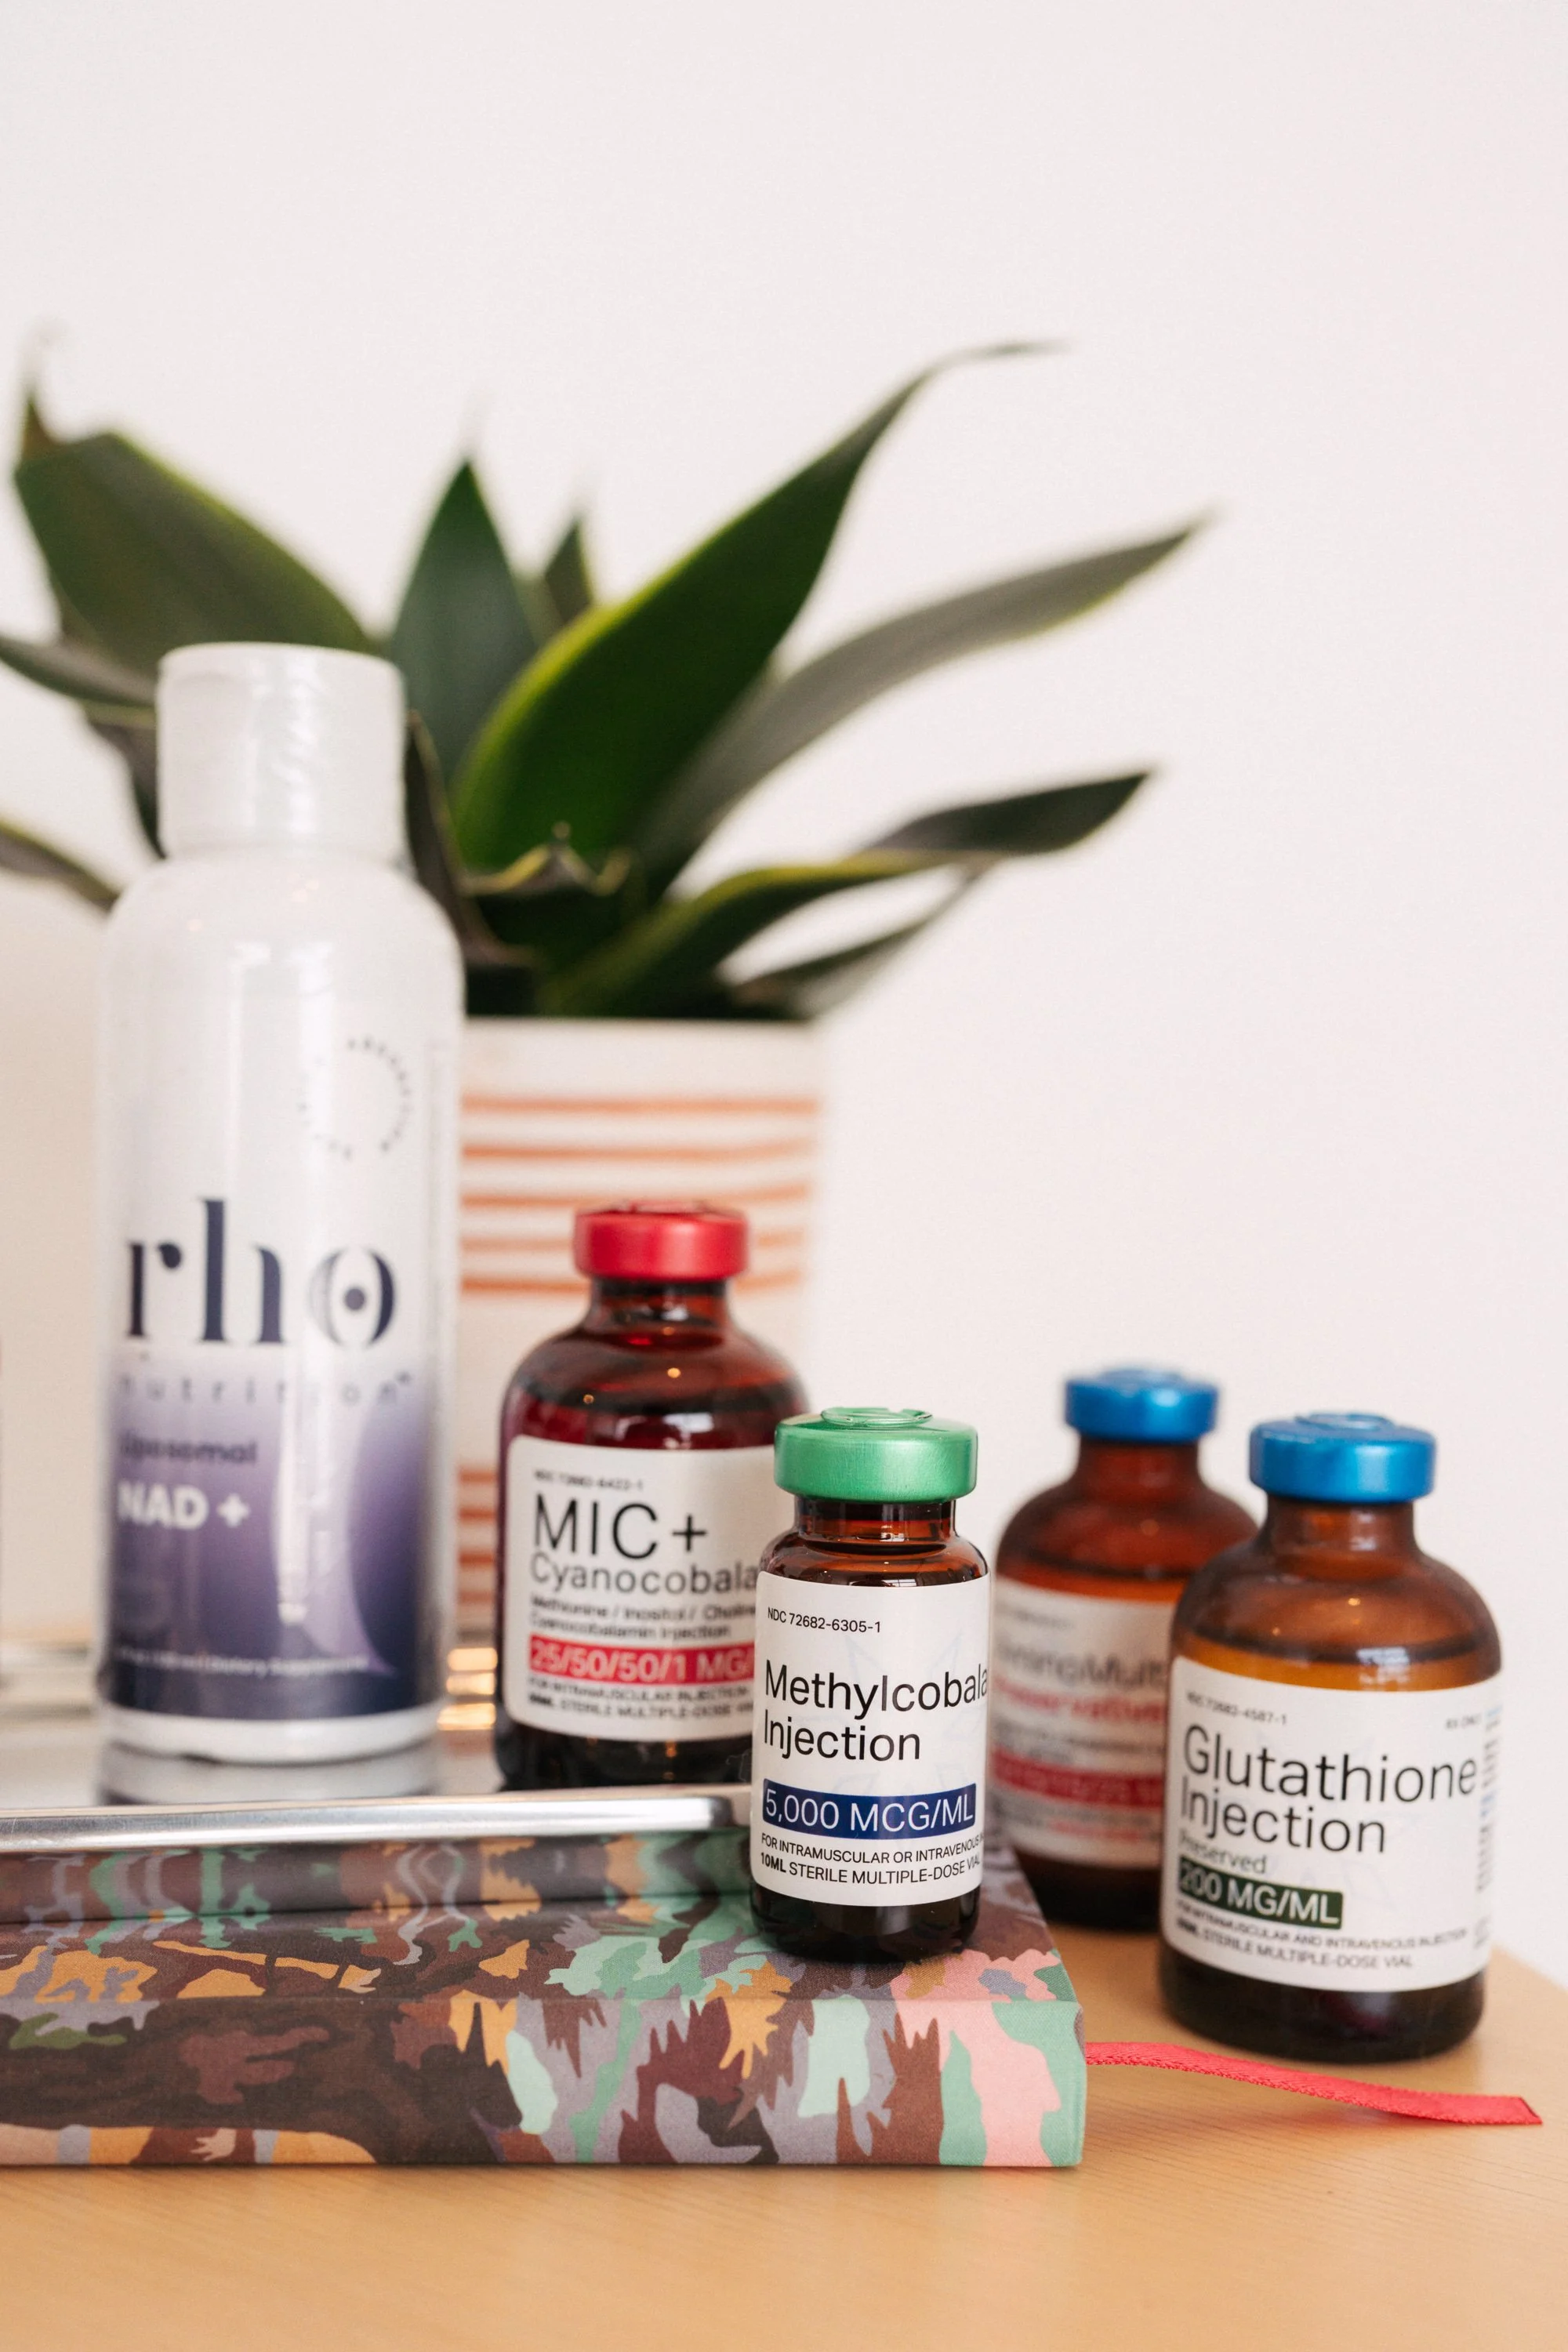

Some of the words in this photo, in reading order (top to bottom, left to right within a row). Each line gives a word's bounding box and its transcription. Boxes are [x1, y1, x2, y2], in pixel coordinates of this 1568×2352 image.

[125, 1197, 397, 1348] rho
[117, 1480, 209, 1530] NAD
[531, 1550, 757, 1595] Cyanocobala
[767, 1606, 786, 1624] NDC
[788, 1612, 882, 1634] 72682-6305-1
[533, 1639, 686, 1683] 25/50/50/1
[764, 1658, 988, 1721] Methylcobala
[764, 1708, 921, 1762] Injection
[1183, 1724, 1478, 1802] Glutathione
[765, 1788, 840, 1831] 5,000
[850, 1793, 974, 1832] MCG/ML
[1180, 1774, 1386, 1853] Injection
[760, 1852, 786, 1873] 10ML
[789, 1860, 848, 1883] STERILE
[851, 1859, 965, 1885] MULTIPLE-DOSE
[761, 1832, 779, 1850] FOR
[779, 1840, 890, 1864] INTRAMUSCULAR
[892, 1851, 912, 1864] OR
[915, 1834, 979, 1863] INTRAVENOUS
[1180, 1860, 1223, 1904] 200
[1227, 1878, 1340, 1925] MG/ML
